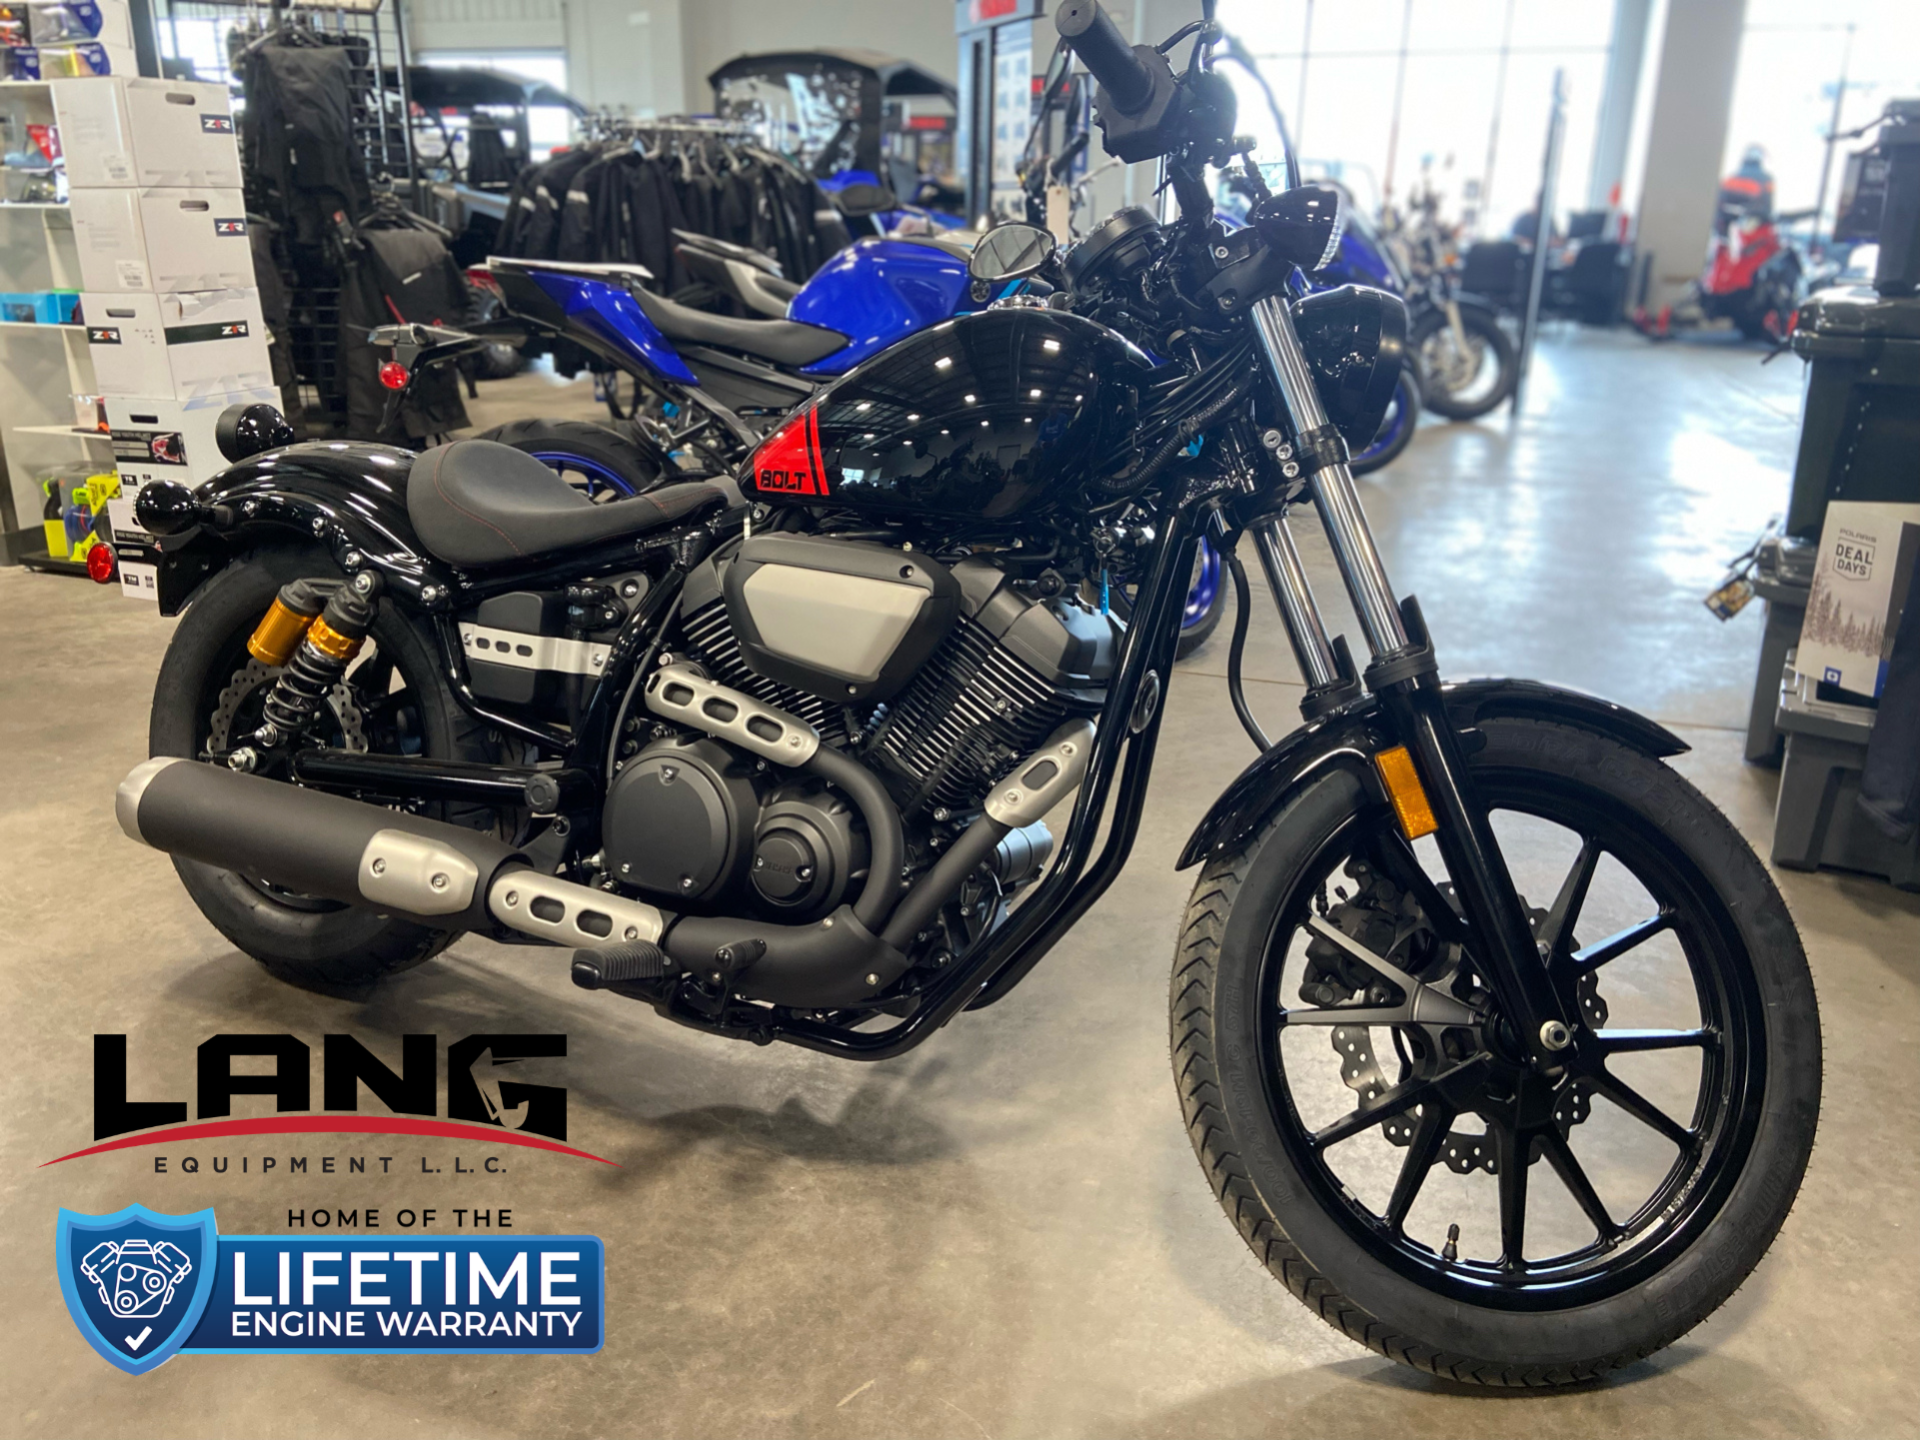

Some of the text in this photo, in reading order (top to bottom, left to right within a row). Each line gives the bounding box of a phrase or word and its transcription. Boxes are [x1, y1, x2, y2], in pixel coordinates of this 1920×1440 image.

[760, 469, 807, 490] BOLT
[1840, 528, 1877, 543] POLARIS
[1836, 543, 1873, 565] DEAL
[1837, 558, 1867, 576] DAYS
